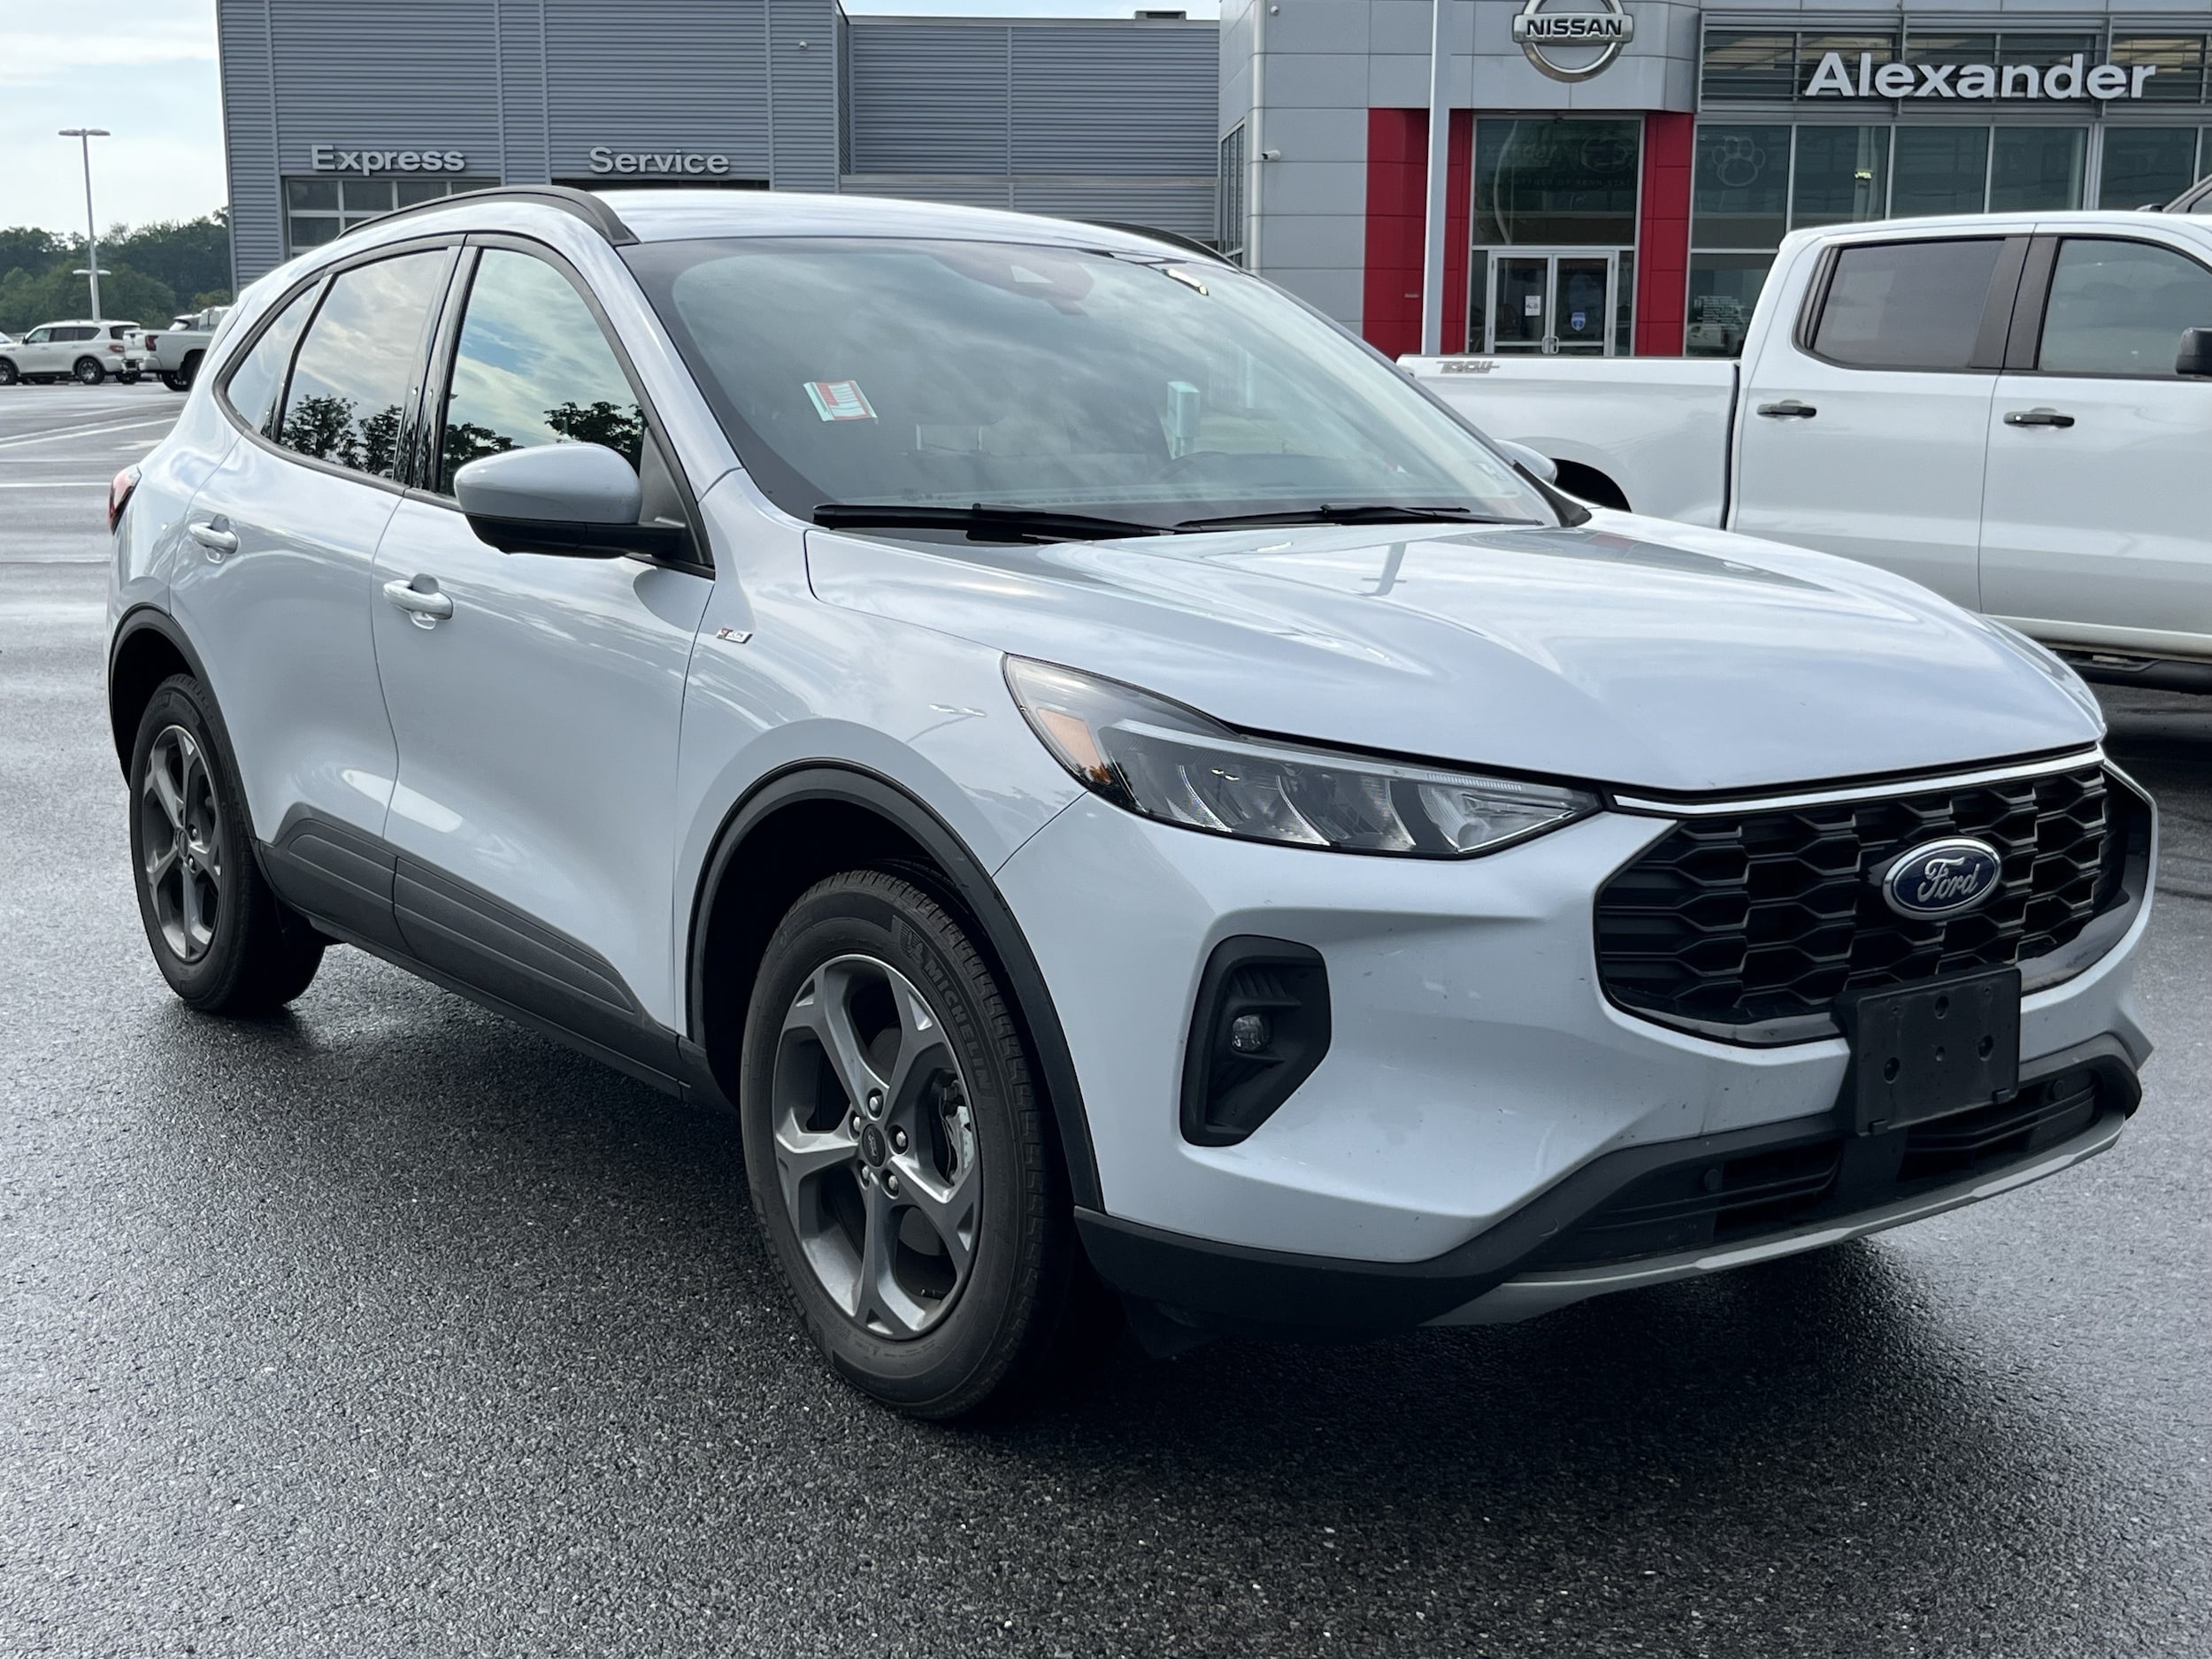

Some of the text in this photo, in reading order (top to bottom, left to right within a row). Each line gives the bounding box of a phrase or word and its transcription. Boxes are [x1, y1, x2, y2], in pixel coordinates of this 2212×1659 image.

[1526, 18, 1623, 37] NISSAN
[1804, 51, 2157, 100] Alexander
[311, 144, 465, 176] Express
[589, 146, 730, 173] Service
[1917, 856, 1980, 902] Ford
[924, 958, 993, 1089] MICHELIN
